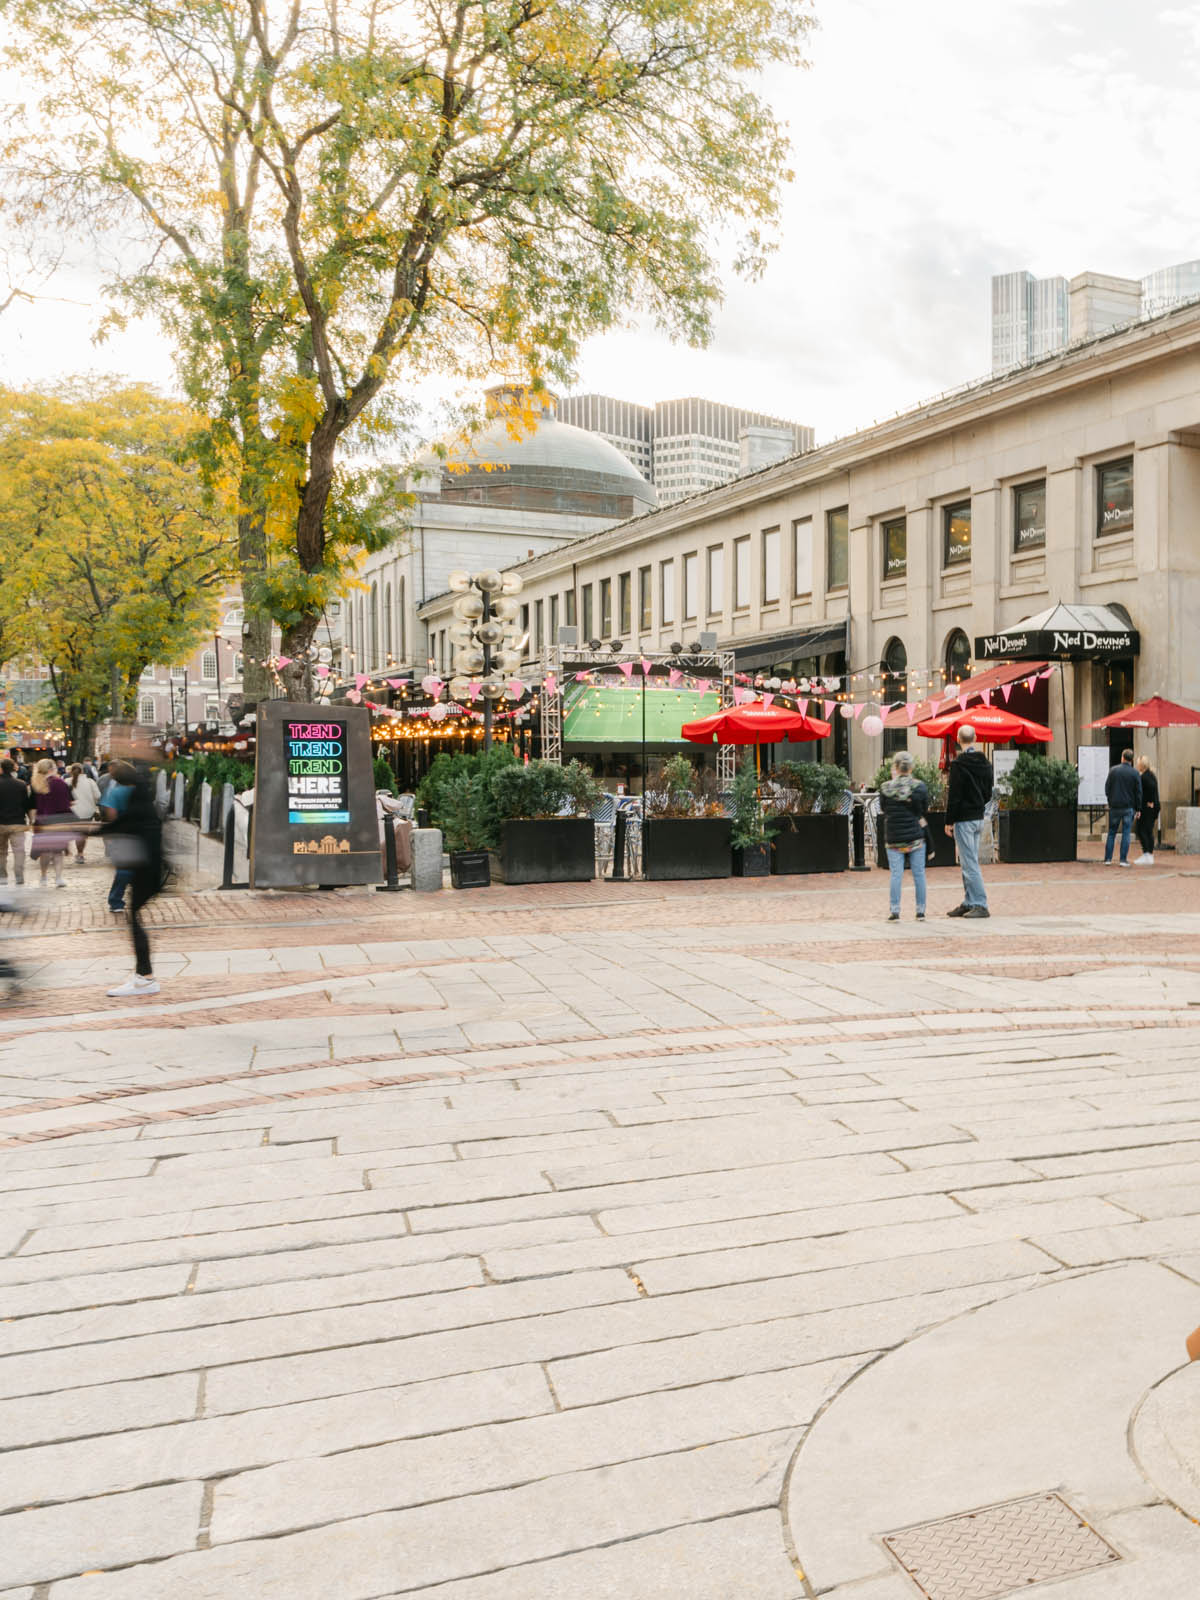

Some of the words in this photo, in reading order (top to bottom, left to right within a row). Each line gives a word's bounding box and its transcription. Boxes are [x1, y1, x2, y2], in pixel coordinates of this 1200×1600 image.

[984, 637, 999, 657] Ned
[1053, 632, 1081, 652] Ned
[289, 724, 342, 739] TREND
[289, 742, 342, 756] TREND
[290, 760, 342, 774] TREND
[289, 777, 341, 794] HERE
